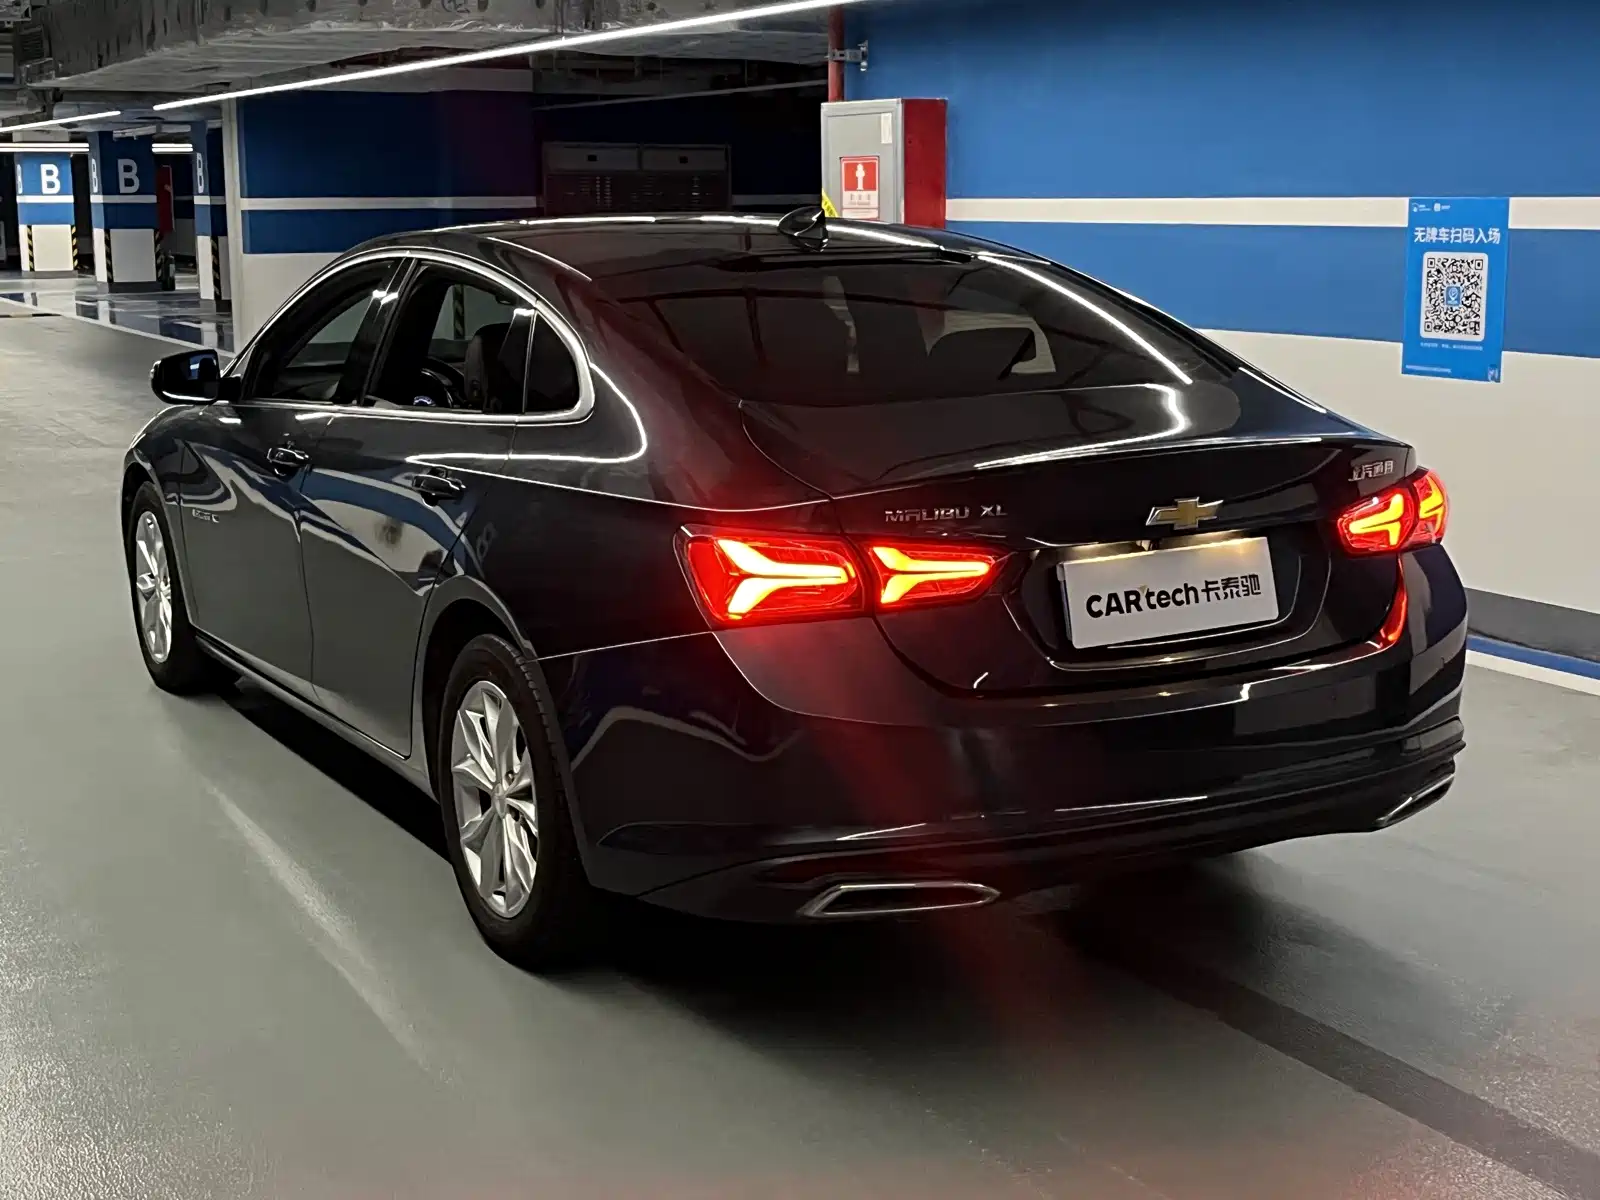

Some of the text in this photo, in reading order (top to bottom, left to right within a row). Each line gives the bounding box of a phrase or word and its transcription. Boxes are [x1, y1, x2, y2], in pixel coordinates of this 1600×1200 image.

[40, 164, 61, 194] B
[117, 159, 140, 194] B
[1414, 227, 1501, 244] 无牌车扫码入场
[885, 504, 1008, 522] MALIBU XL
